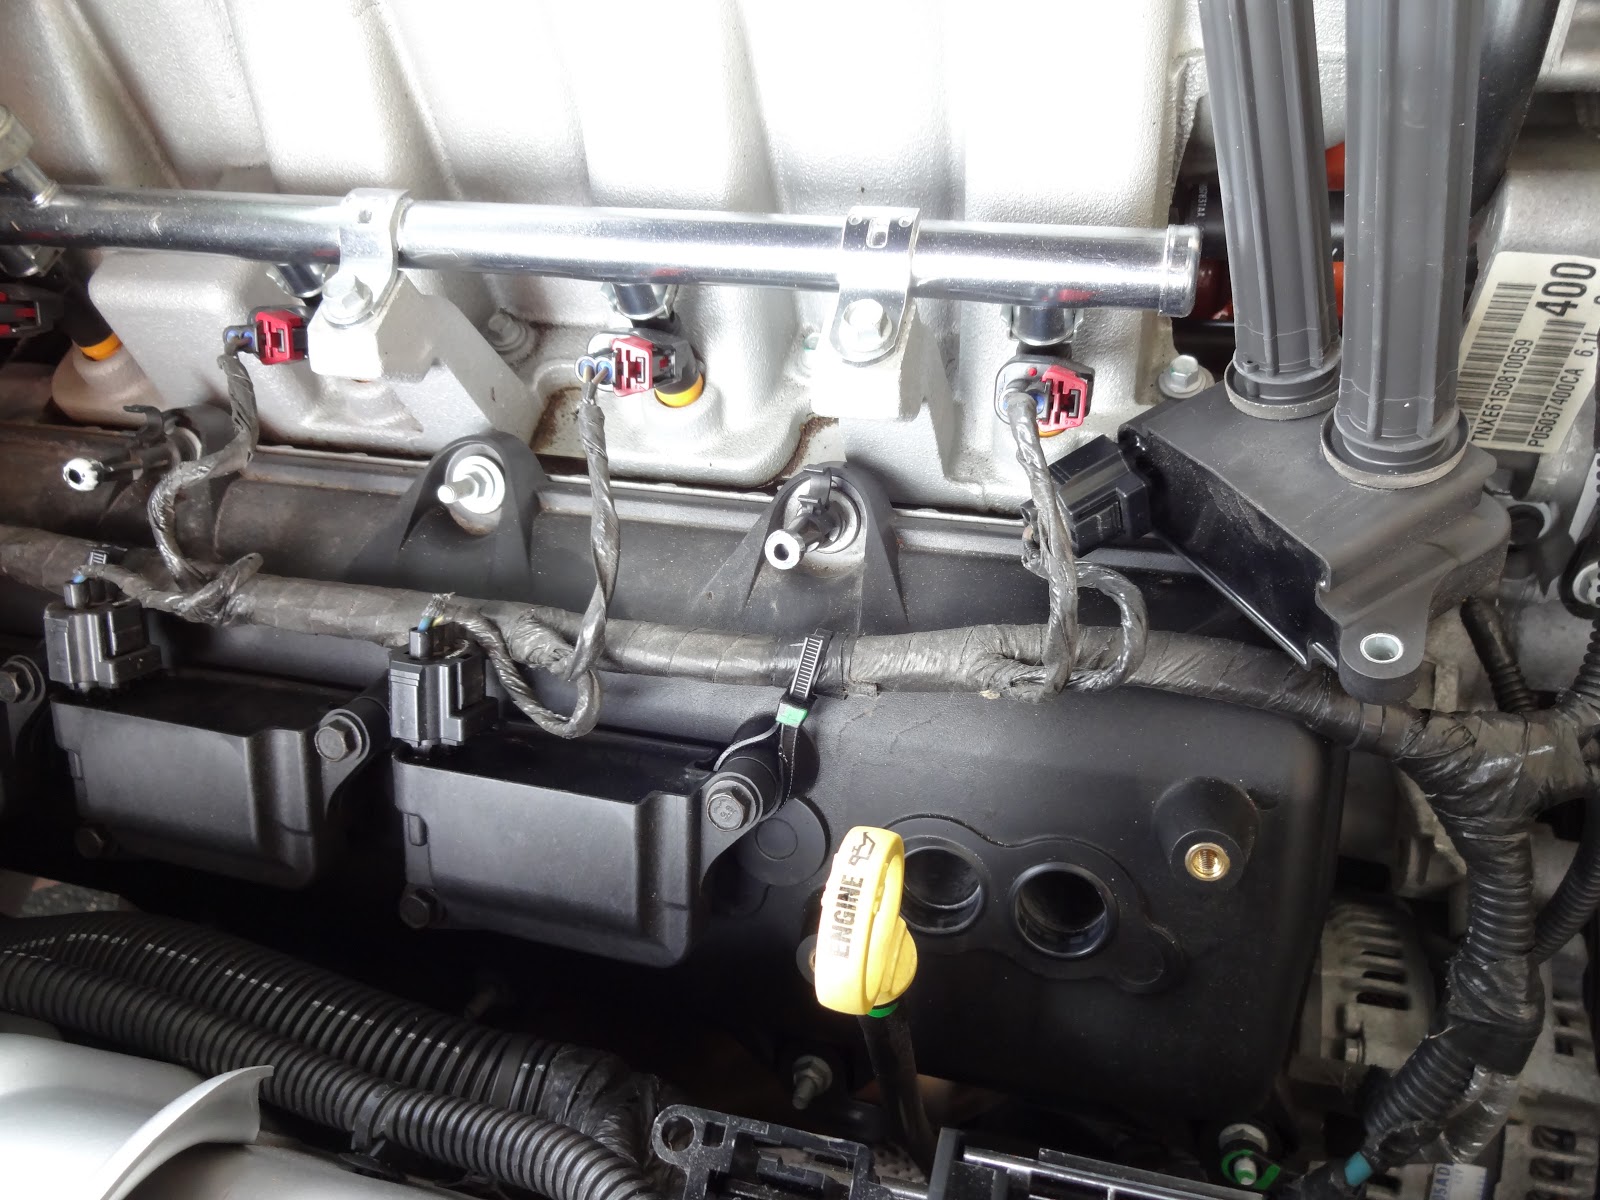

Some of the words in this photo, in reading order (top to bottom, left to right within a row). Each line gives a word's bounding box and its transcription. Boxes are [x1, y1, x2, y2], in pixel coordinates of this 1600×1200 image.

[1535, 262, 1597, 317] 400
[1471, 339, 1534, 442] TNXE6150810059
[1528, 368, 1584, 448] P05037400CA
[830, 874, 864, 960] ENGINE
